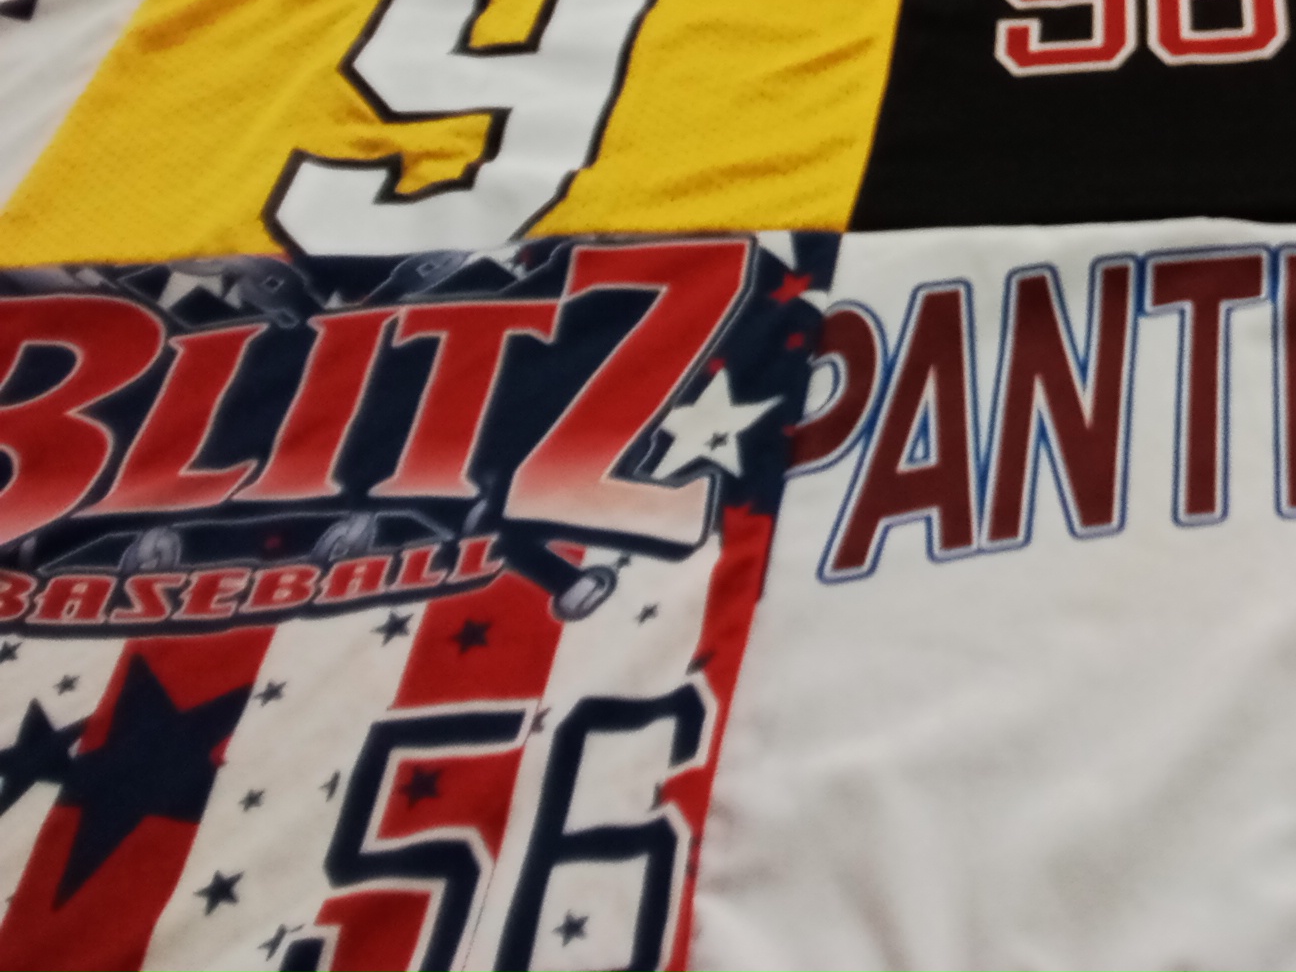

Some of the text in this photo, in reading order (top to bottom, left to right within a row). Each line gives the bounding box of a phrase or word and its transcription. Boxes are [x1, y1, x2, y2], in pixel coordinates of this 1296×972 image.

[0, 236, 759, 555] BLITZ
[0, 533, 506, 625] BASEBALL
[275, 680, 720, 972] 56
